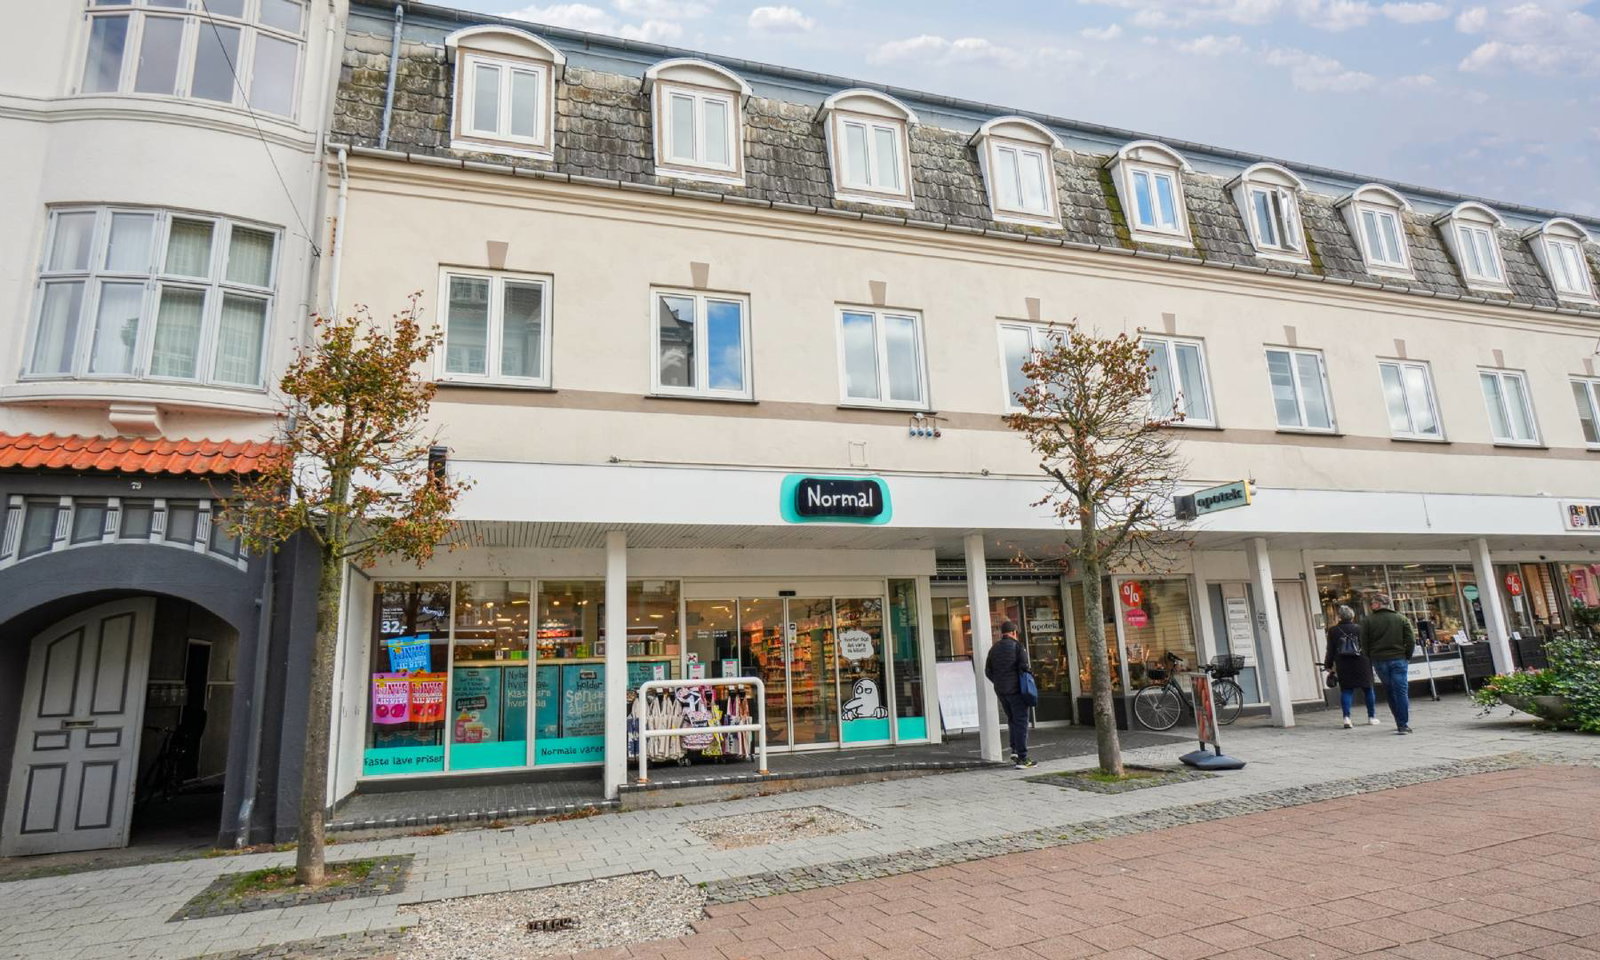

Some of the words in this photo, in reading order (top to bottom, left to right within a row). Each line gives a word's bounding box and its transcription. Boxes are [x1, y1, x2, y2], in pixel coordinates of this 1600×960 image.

[807, 484, 873, 508] Normal
[1196, 488, 1243, 509] apotek
[1031, 622, 1058, 631] apotek
